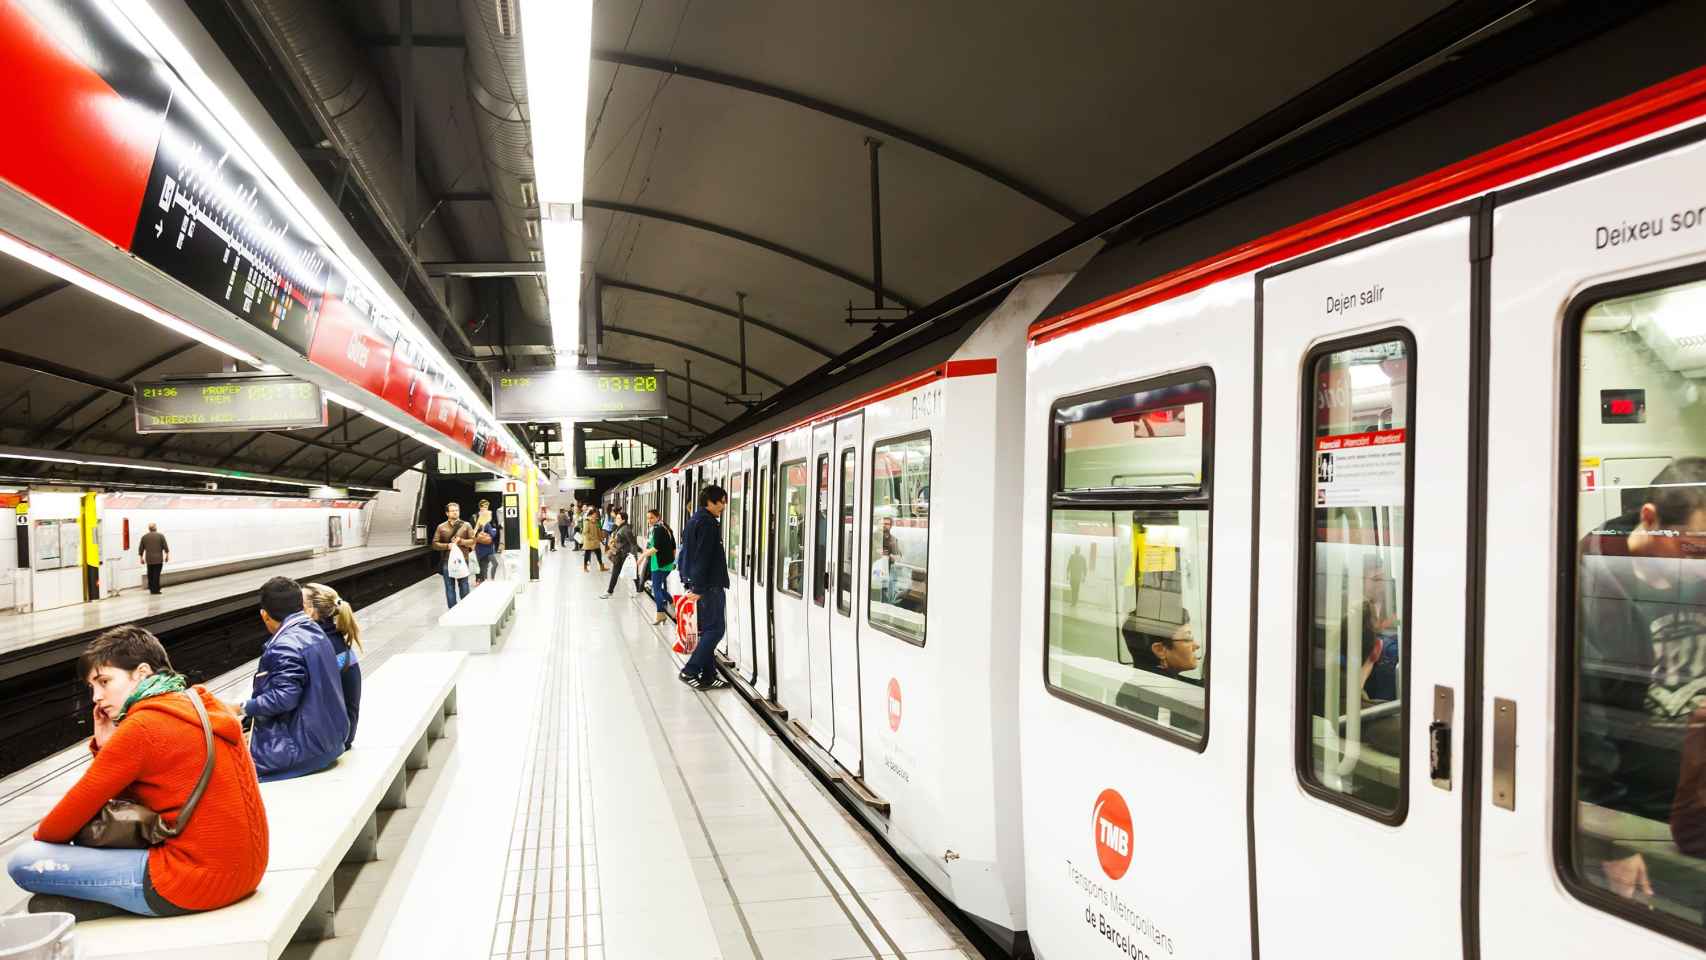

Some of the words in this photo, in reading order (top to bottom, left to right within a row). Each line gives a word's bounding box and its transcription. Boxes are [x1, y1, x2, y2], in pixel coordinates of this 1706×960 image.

[1595, 218, 1664, 250] Deixeu
[1326, 292, 1357, 315] Dejen
[1360, 283, 1385, 306] salir
[143, 386, 178, 398] 21:36
[598, 375, 657, 393] 03:20
[1099, 816, 1129, 857] TMB
[1065, 859, 1109, 907] Transports
[1109, 890, 1174, 956] Metropolitans
[1085, 903, 1097, 929] de
